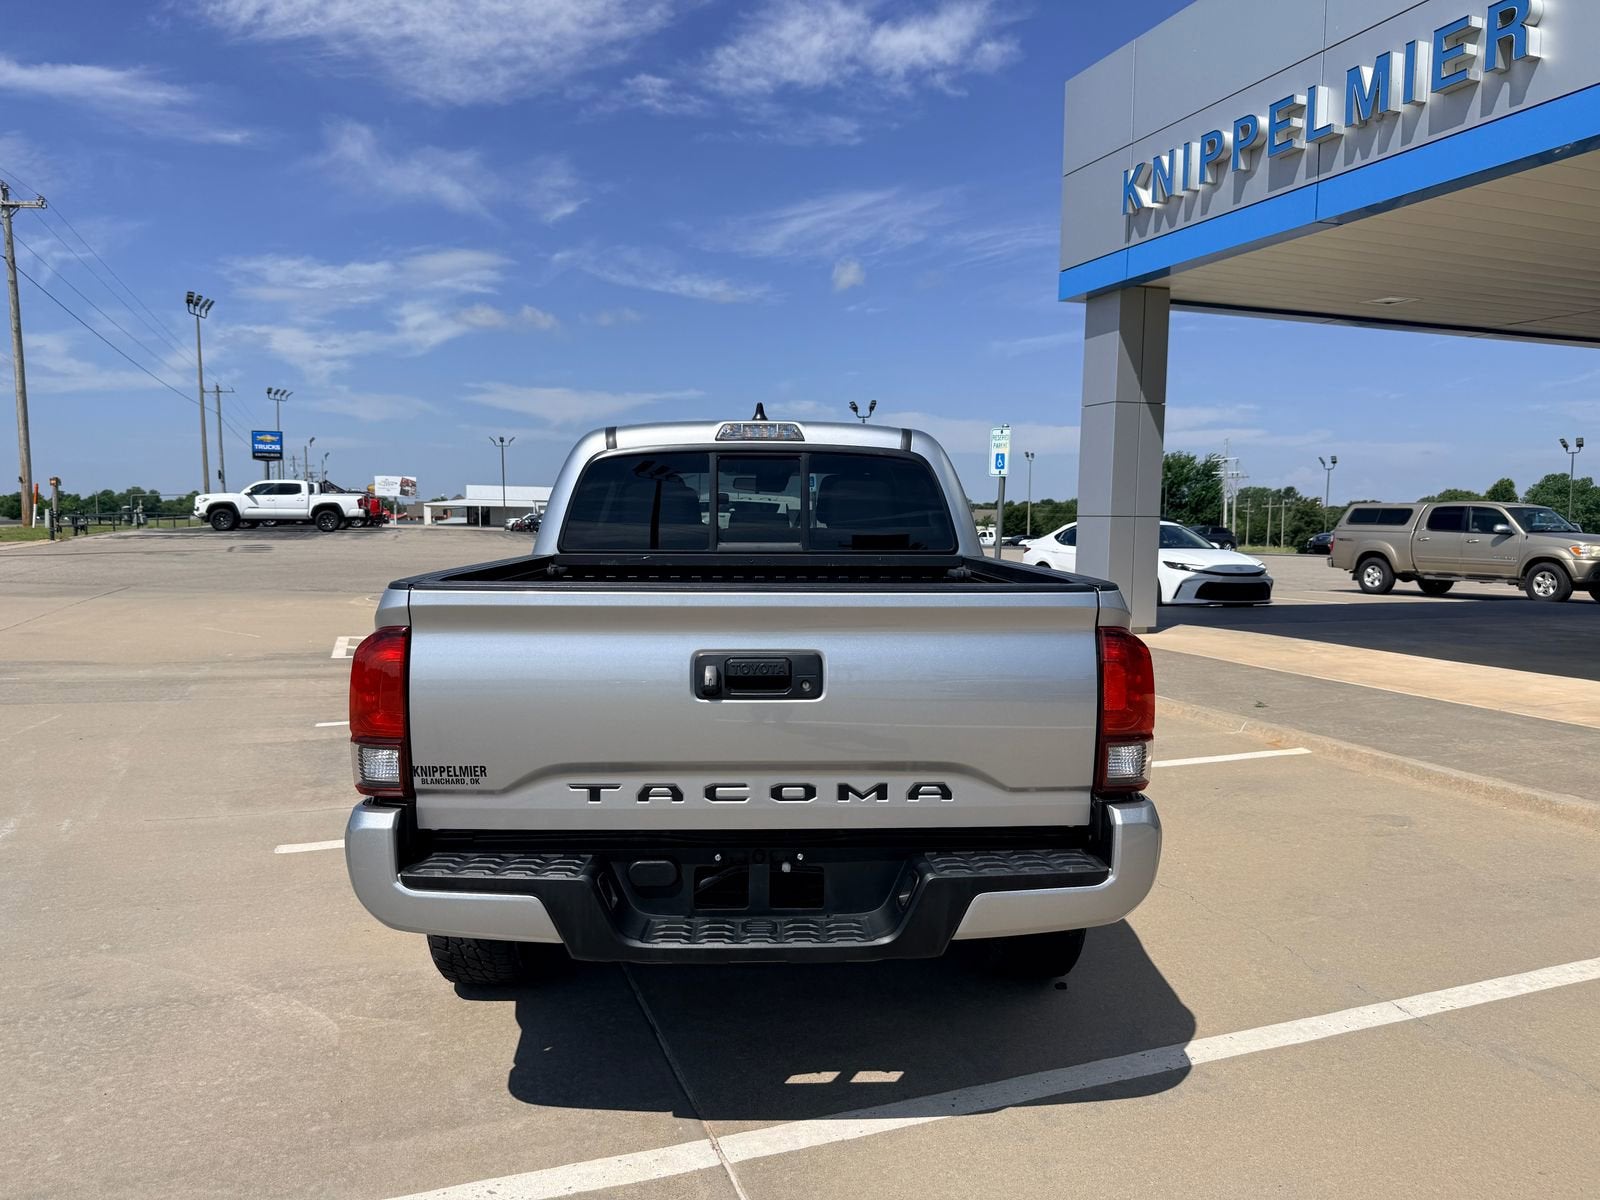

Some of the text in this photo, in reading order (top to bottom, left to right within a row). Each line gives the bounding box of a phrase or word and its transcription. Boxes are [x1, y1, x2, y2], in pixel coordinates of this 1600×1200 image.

[1122, 0, 1541, 215] KNIPPELMIER
[731, 663, 787, 675] TOYOTA
[412, 765, 487, 778] KNIPPELMIER
[421, 778, 469, 786] BLANCHARD,
[568, 782, 954, 804] TACOMA
